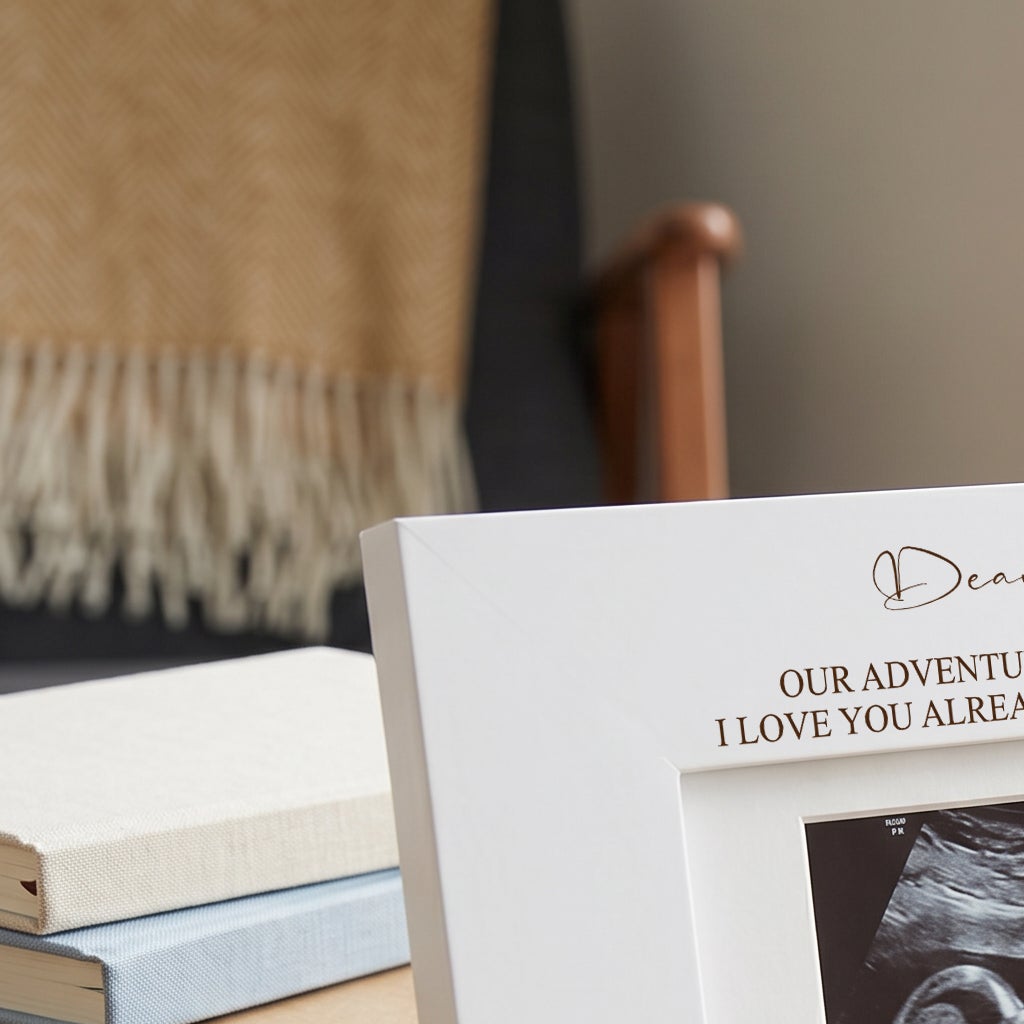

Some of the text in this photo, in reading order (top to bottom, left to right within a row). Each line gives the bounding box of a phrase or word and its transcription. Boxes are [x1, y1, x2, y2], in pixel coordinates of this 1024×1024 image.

[779, 665, 856, 699] OUR
[714, 718, 729, 747] I
[735, 707, 833, 746] LOVE
[837, 701, 913, 736] YOU
